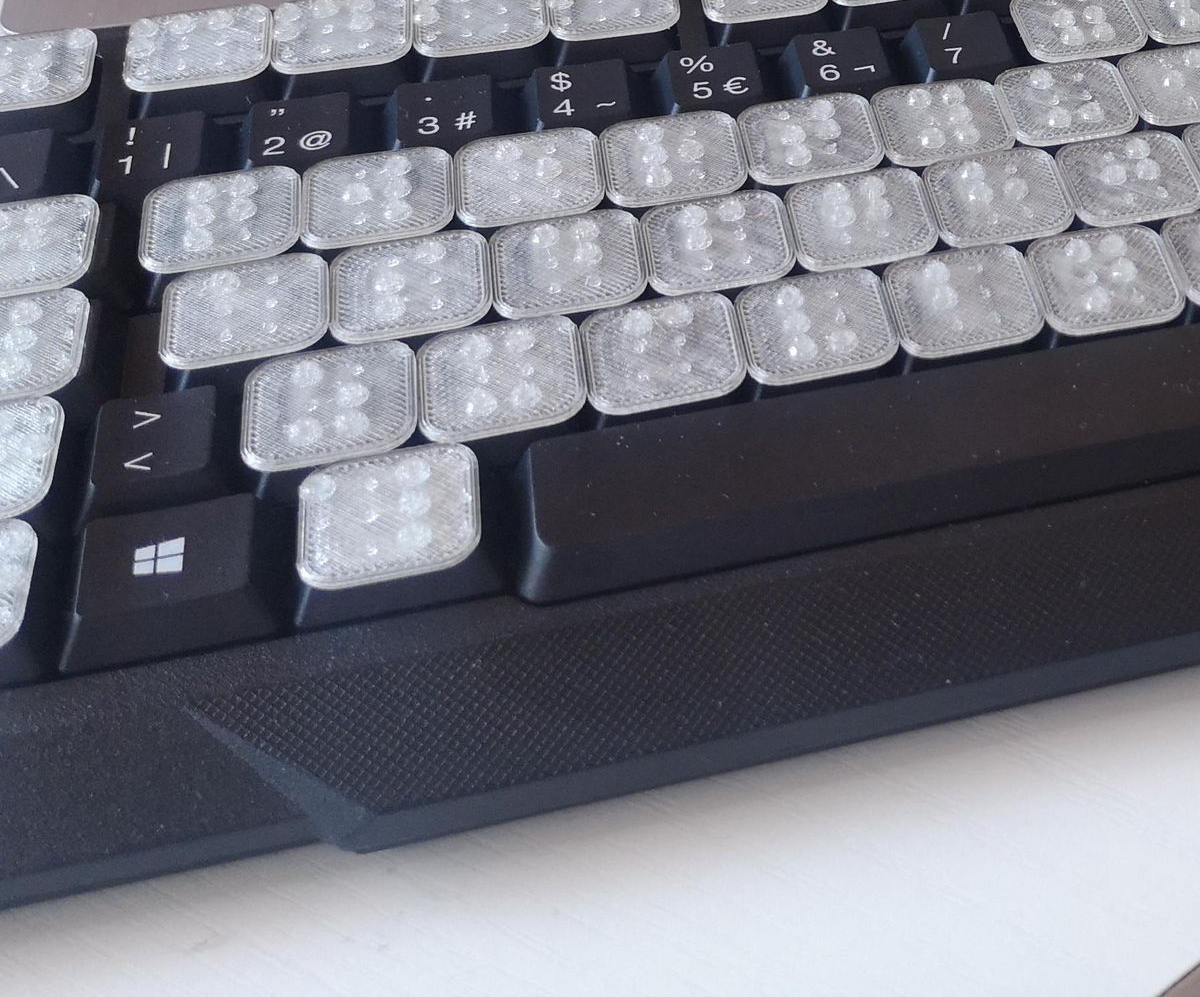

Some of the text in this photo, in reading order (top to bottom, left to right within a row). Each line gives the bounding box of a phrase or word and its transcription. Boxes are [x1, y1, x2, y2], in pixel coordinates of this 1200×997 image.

[812, 40, 836, 57] &
[944, 47, 963, 64] 7
[680, 56, 714, 74] %
[820, 64, 840, 81] 6
[551, 72, 572, 92] $
[693, 77, 749, 99] 5 €
[553, 99, 575, 117] 4
[417, 111, 478, 135] 3 #
[262, 131, 332, 156] 2 @
[118, 155, 133, 176] 1
